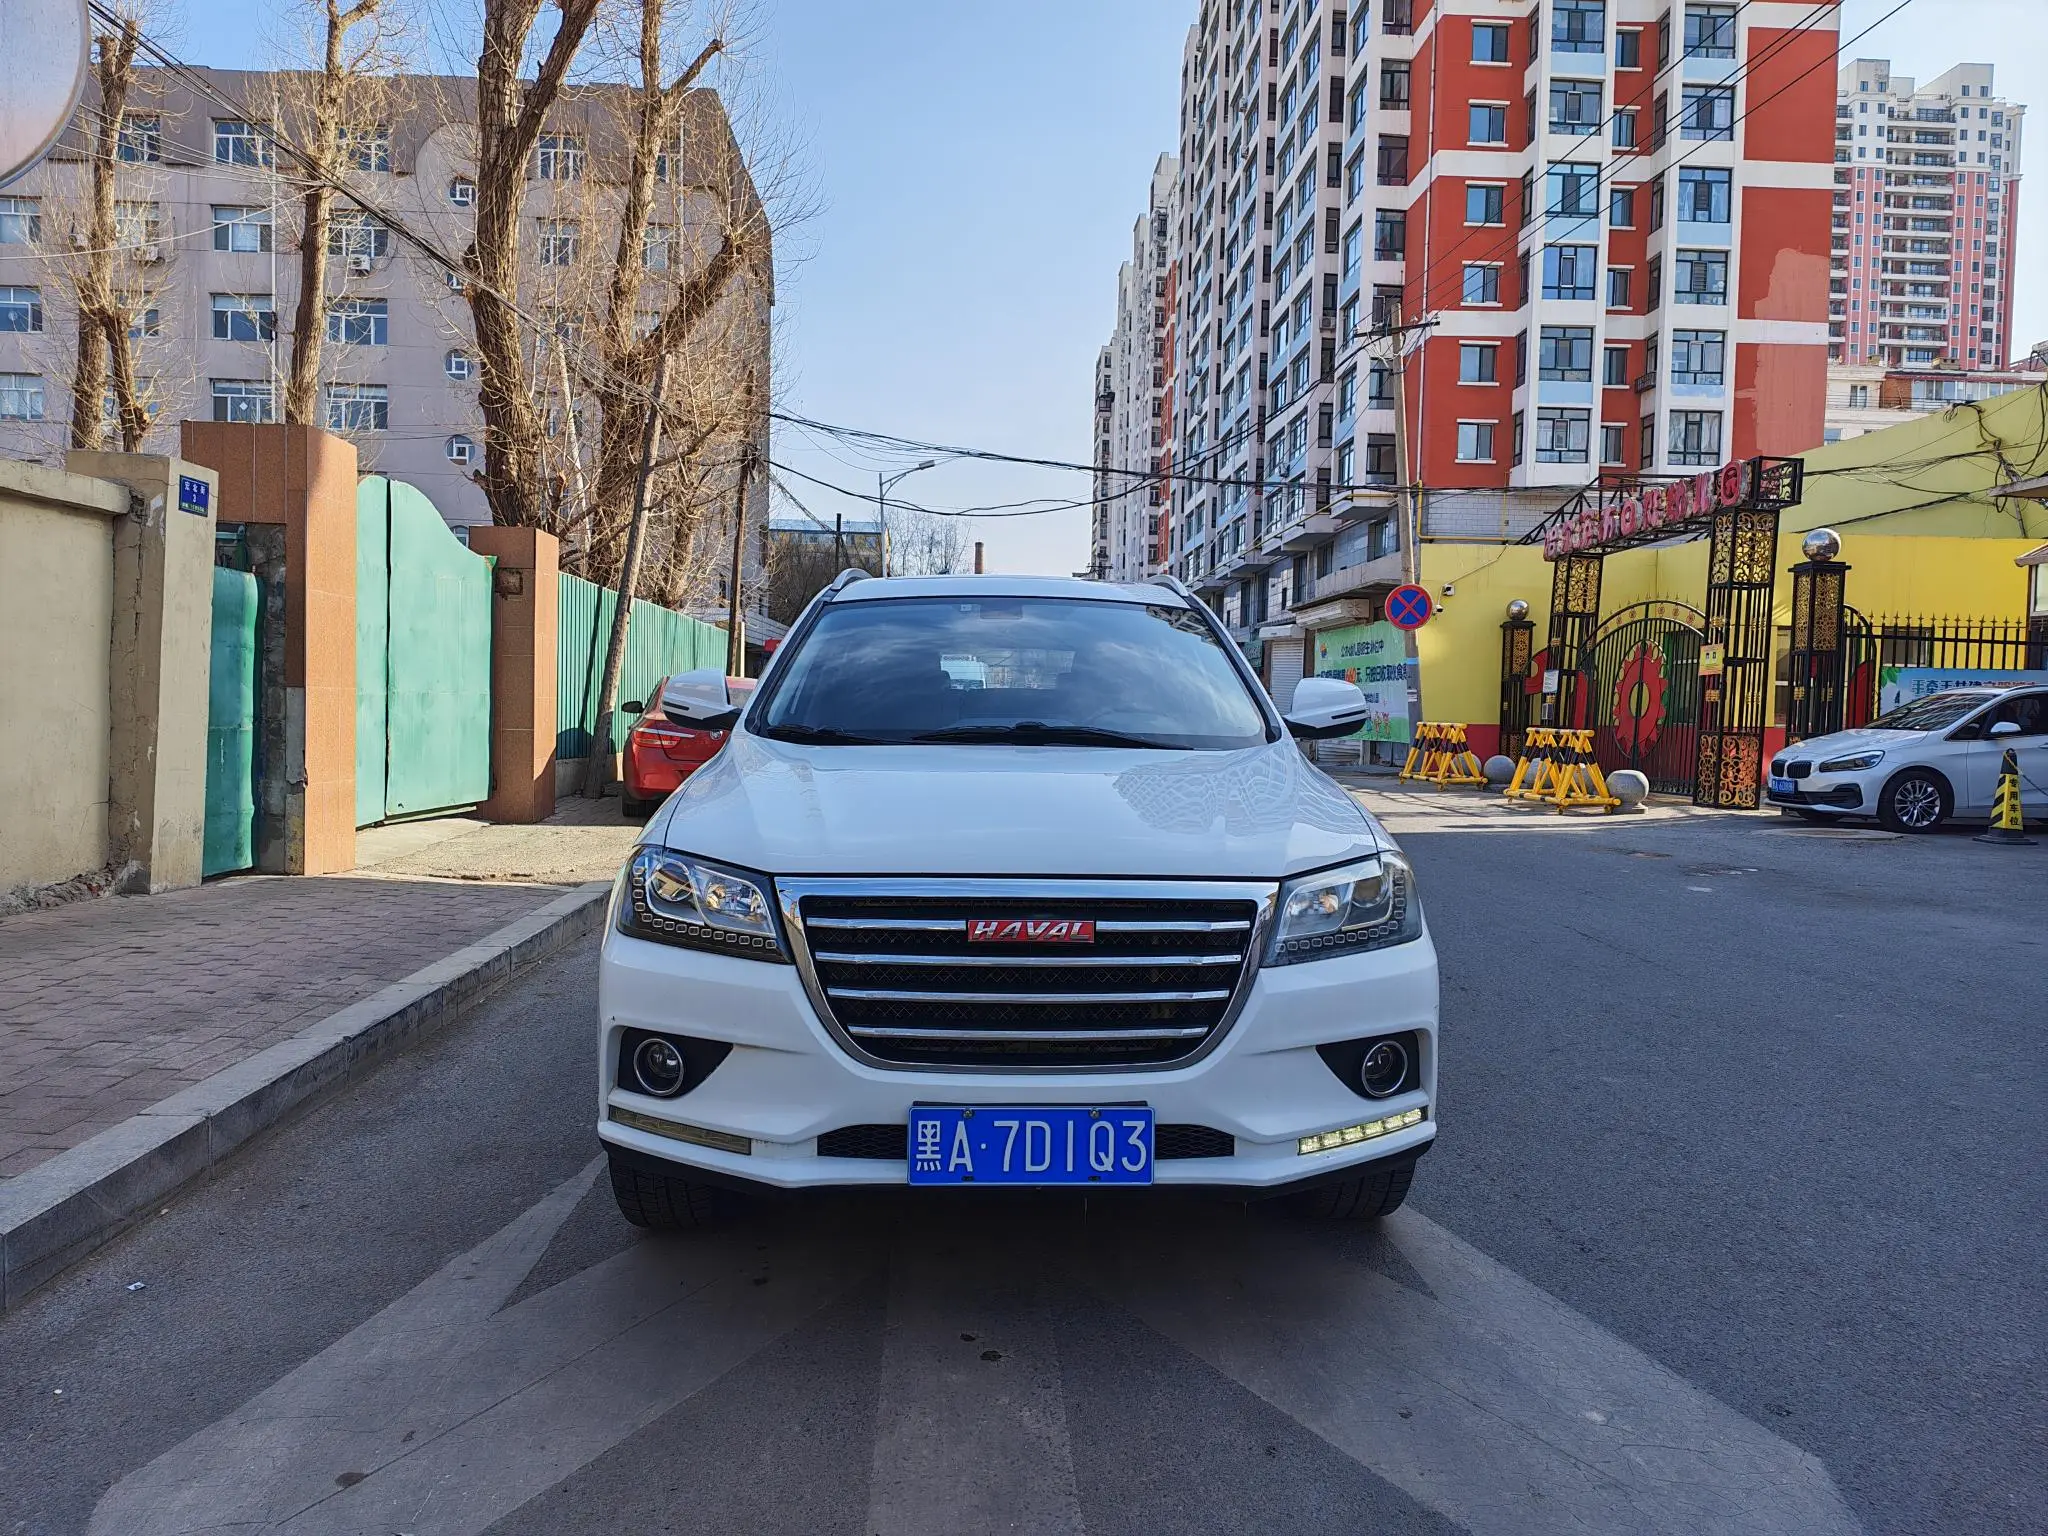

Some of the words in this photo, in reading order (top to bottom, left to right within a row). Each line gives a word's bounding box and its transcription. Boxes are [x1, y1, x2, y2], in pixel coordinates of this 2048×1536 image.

[2009, 778, 2020, 826] 专用车位
[973, 921, 1090, 939] HAVAL
[916, 1120, 1147, 1172] 黑A·7D1Q3
